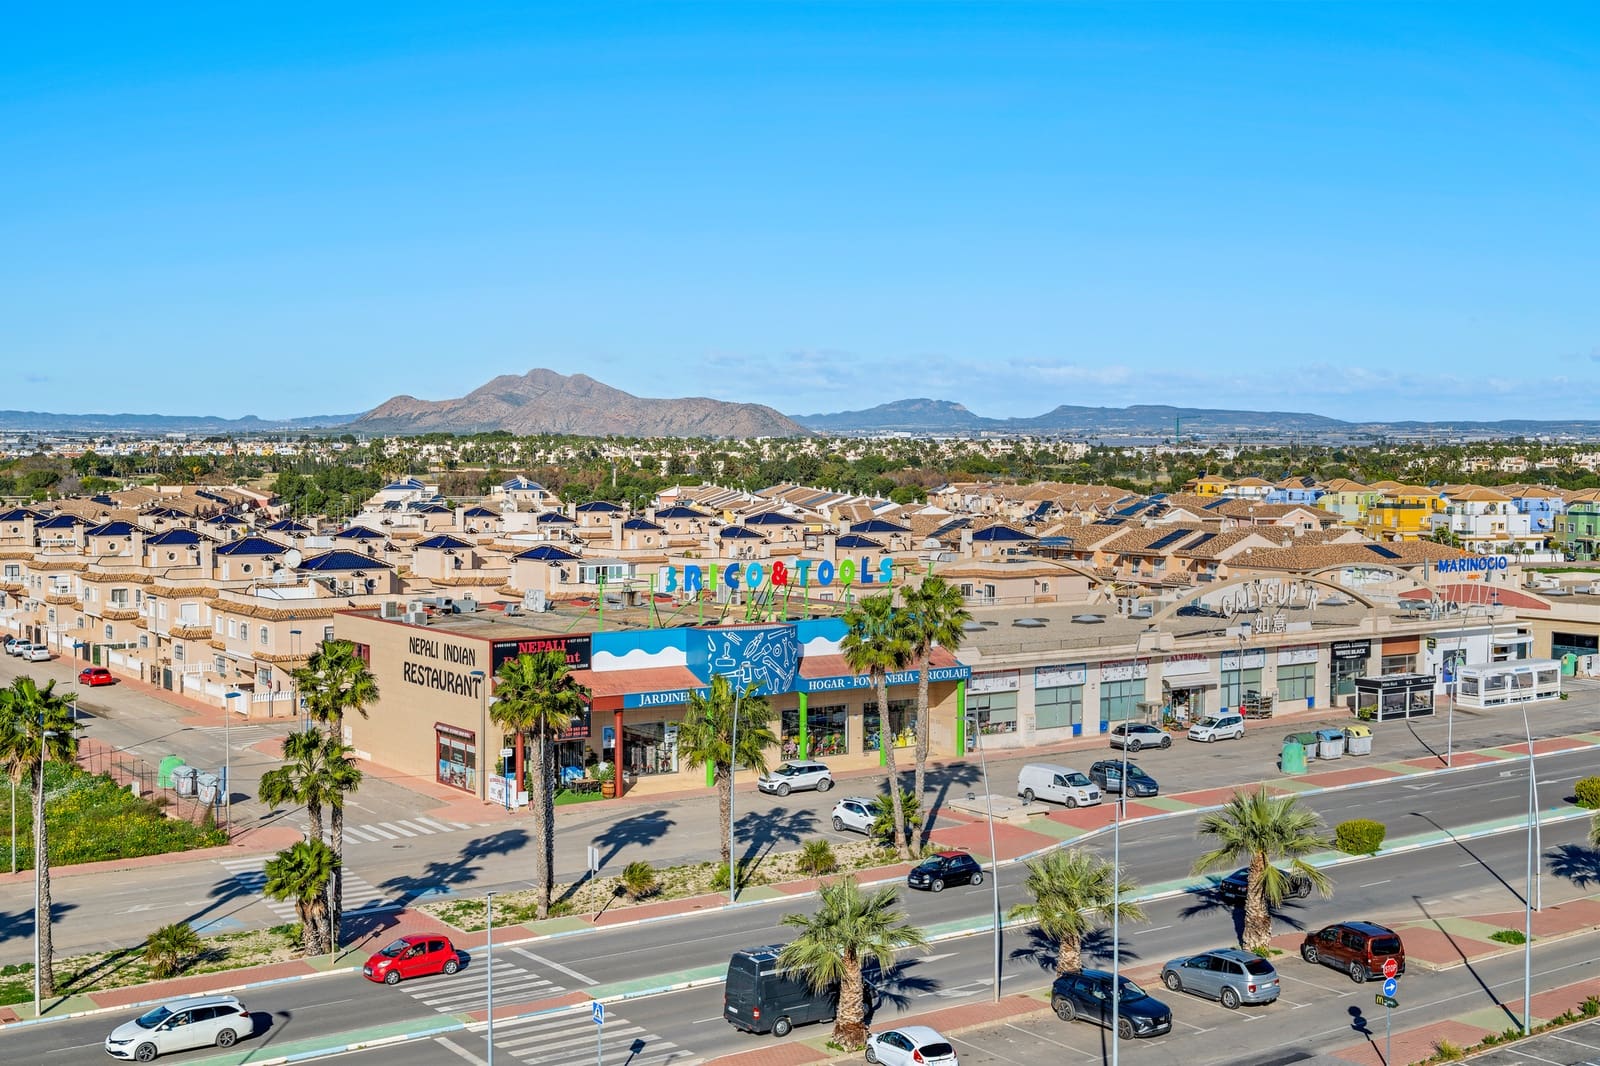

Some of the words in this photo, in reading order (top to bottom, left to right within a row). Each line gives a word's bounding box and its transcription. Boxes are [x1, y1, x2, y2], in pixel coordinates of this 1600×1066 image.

[1438, 556, 1507, 573] MARINOCIO
[1222, 583, 1319, 617] GALYSUPR
[1256, 613, 1287, 634] 如意
[409, 636, 439, 660] NEPALI
[444, 643, 475, 667] INDIAN
[518, 640, 567, 654] NEPALI
[404, 661, 481, 699] RESTAURANT
[809, 679, 845, 690] HOGAR
[853, 671, 914, 688] FONNERÍA
[920, 667, 969, 681] RICOLAJE
